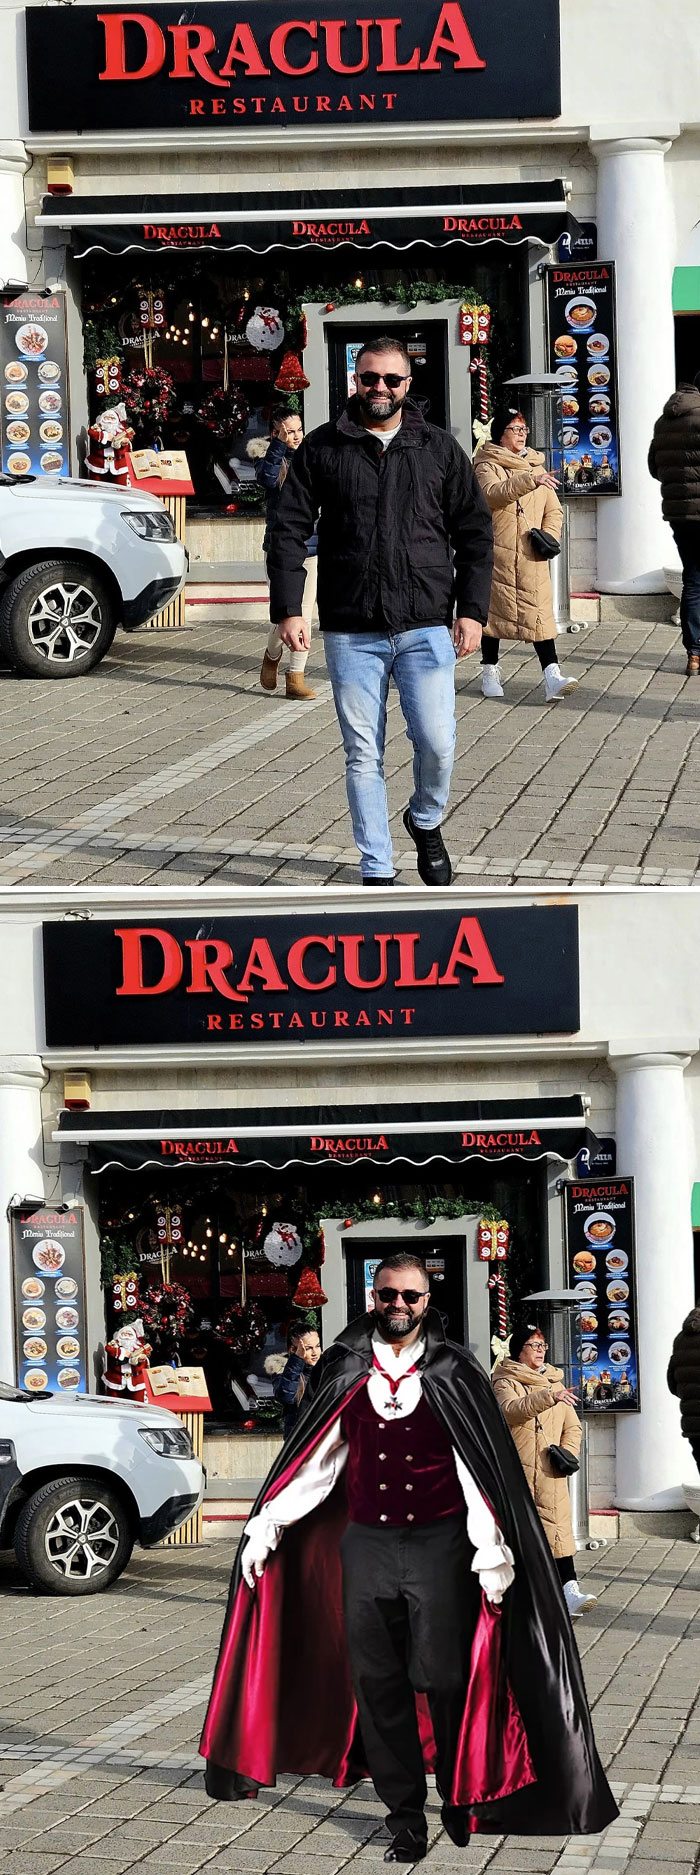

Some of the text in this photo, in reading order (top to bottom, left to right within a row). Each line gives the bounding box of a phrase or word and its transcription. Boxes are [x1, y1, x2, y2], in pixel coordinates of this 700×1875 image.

[96, 1, 486, 88] DRACULA
[188, 93, 398, 116] RESTAURANT
[143, 223, 222, 241] DRACULA
[292, 219, 371, 237] DRACULA
[441, 214, 523, 232] DRACULA
[552, 267, 609, 282] DRACULA
[3, 297, 60, 309] DRACULA
[4, 313, 27, 324] Meniu
[114, 916, 505, 1003] DRACULA
[206, 1008, 416, 1031] RESTAURANT
[160, 1138, 239, 1156] DRACULA
[310, 1135, 389, 1153] DRACULA
[461, 1130, 542, 1148] DRACULA
[571, 1183, 629, 1199] DRACULA
[20, 1212, 77, 1225] DRACULA
[21, 1229, 44, 1240] Meniu
